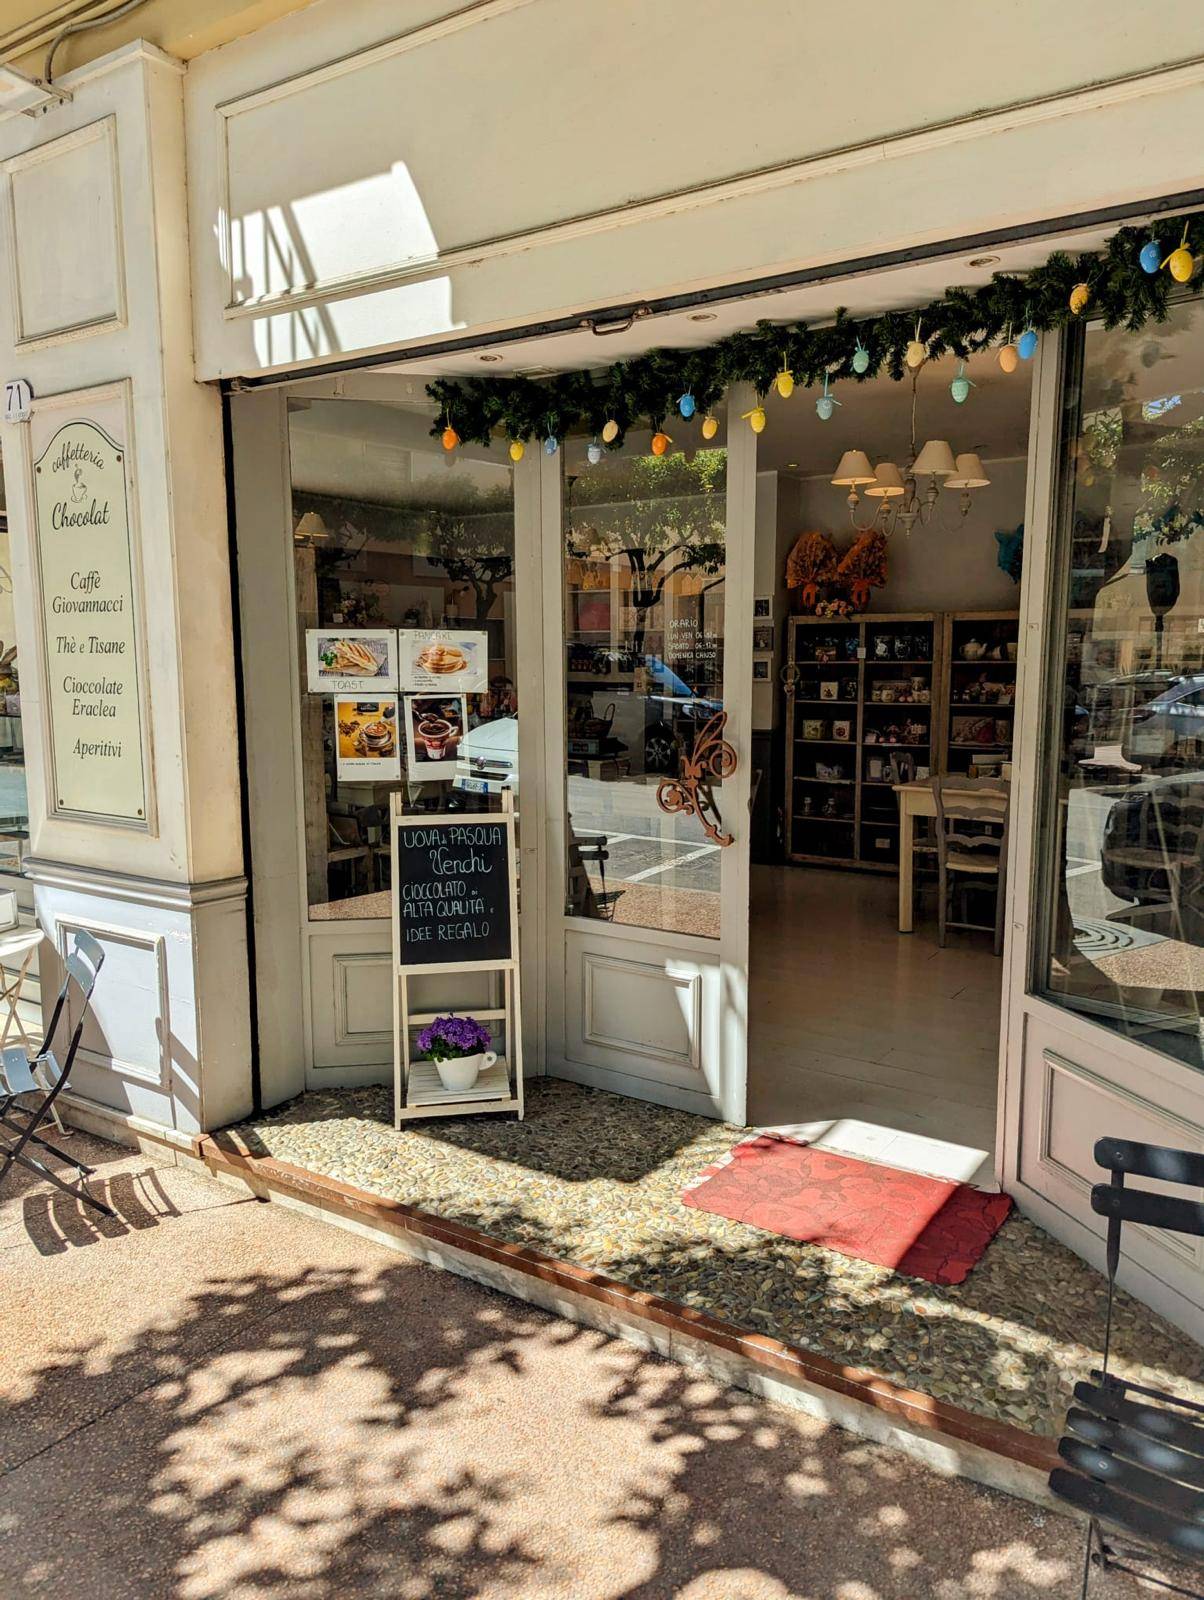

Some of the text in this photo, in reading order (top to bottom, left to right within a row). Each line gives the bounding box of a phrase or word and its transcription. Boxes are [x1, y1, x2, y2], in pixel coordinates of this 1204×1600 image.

[6, 384, 23, 411] 71
[52, 441, 104, 473] caffetteria
[52, 498, 110, 530] Chocolat
[52, 595, 124, 614] Giovannacci
[669, 618, 698, 628] ORARIO
[56, 636, 126, 654] Thè e Tisane
[696, 651, 716, 659] CHIUSO
[63, 675, 124, 695] Cioccolate
[330, 680, 365, 690] TOAST
[72, 698, 116, 718] Eraclea
[72, 738, 122, 760] Aperitivi
[404, 829, 441, 848] UOVA
[448, 826, 502, 846] PASQUA
[430, 846, 493, 875] Venchi
[403, 901, 434, 918] ALTA
[406, 922, 490, 942] IDEE REGALO
